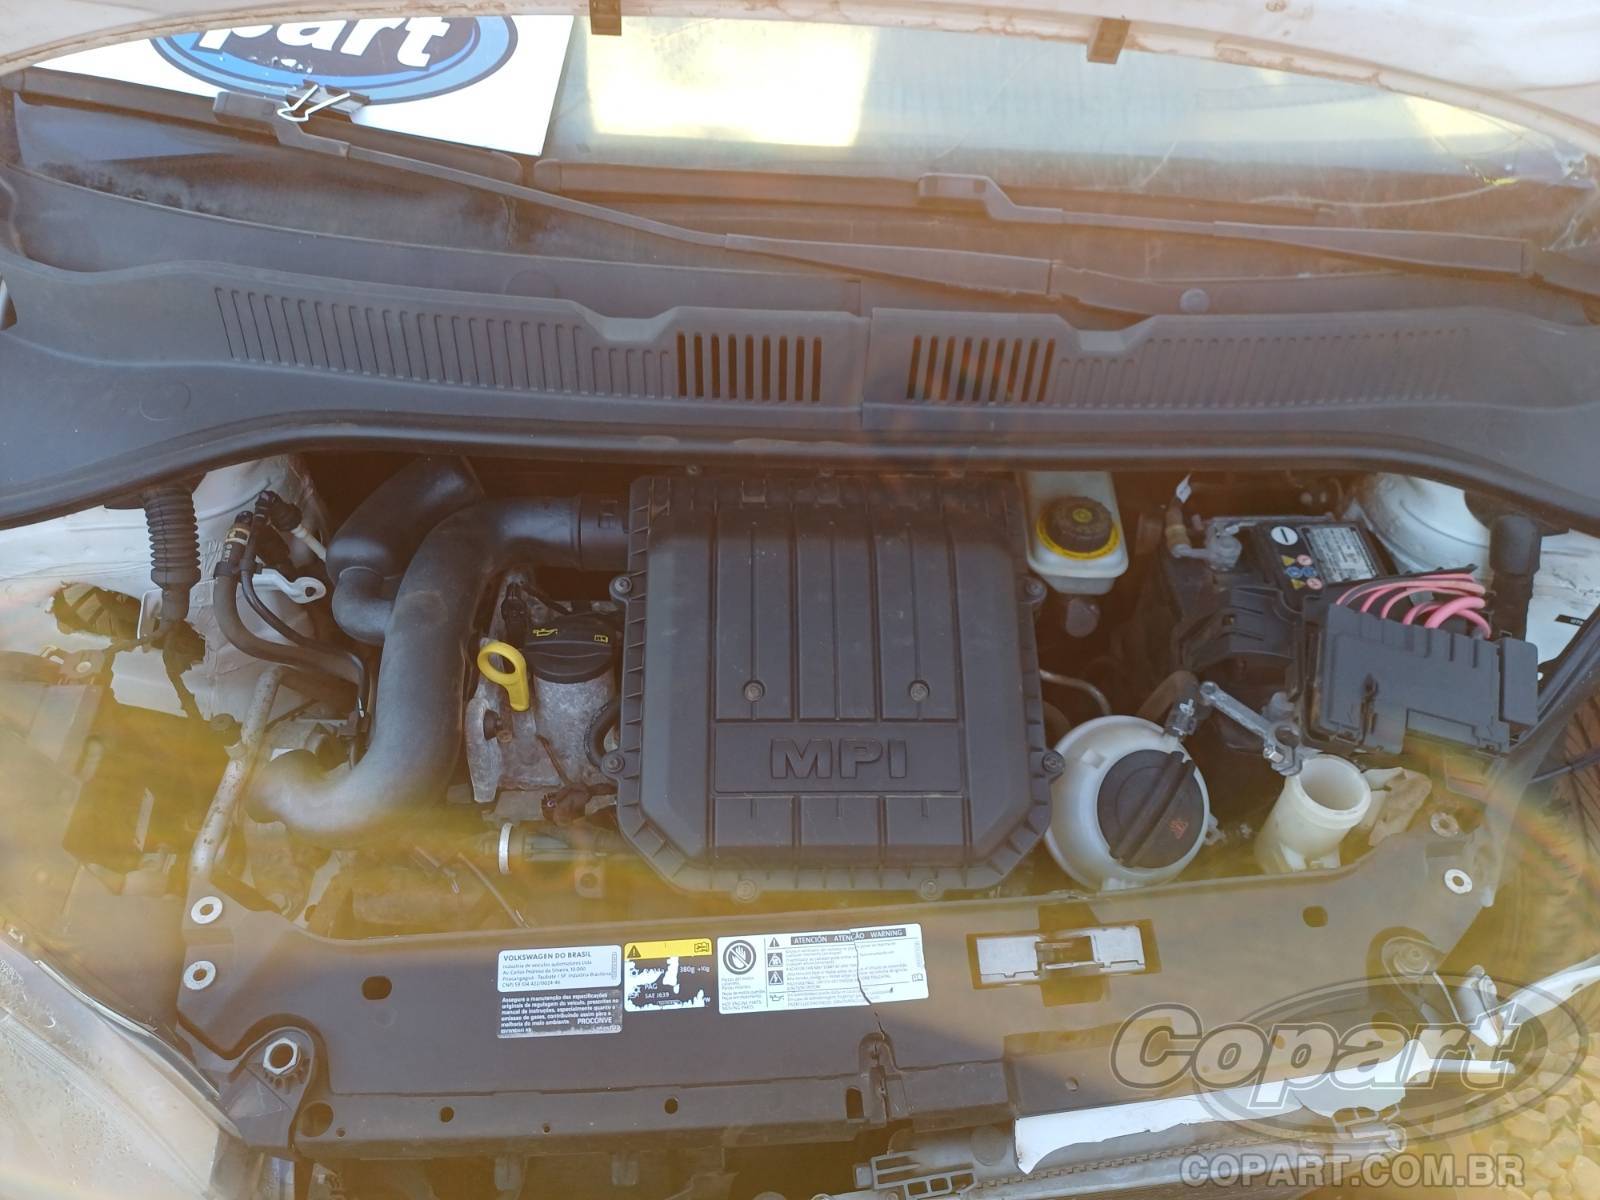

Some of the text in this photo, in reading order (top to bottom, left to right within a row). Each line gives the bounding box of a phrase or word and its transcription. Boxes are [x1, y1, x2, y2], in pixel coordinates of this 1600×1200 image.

[769, 738, 907, 779] MPI
[870, 929, 903, 938] WARNING
[503, 953, 553, 961] VOLKSWAGEN
[577, 1016, 612, 1025] PROCONVE
